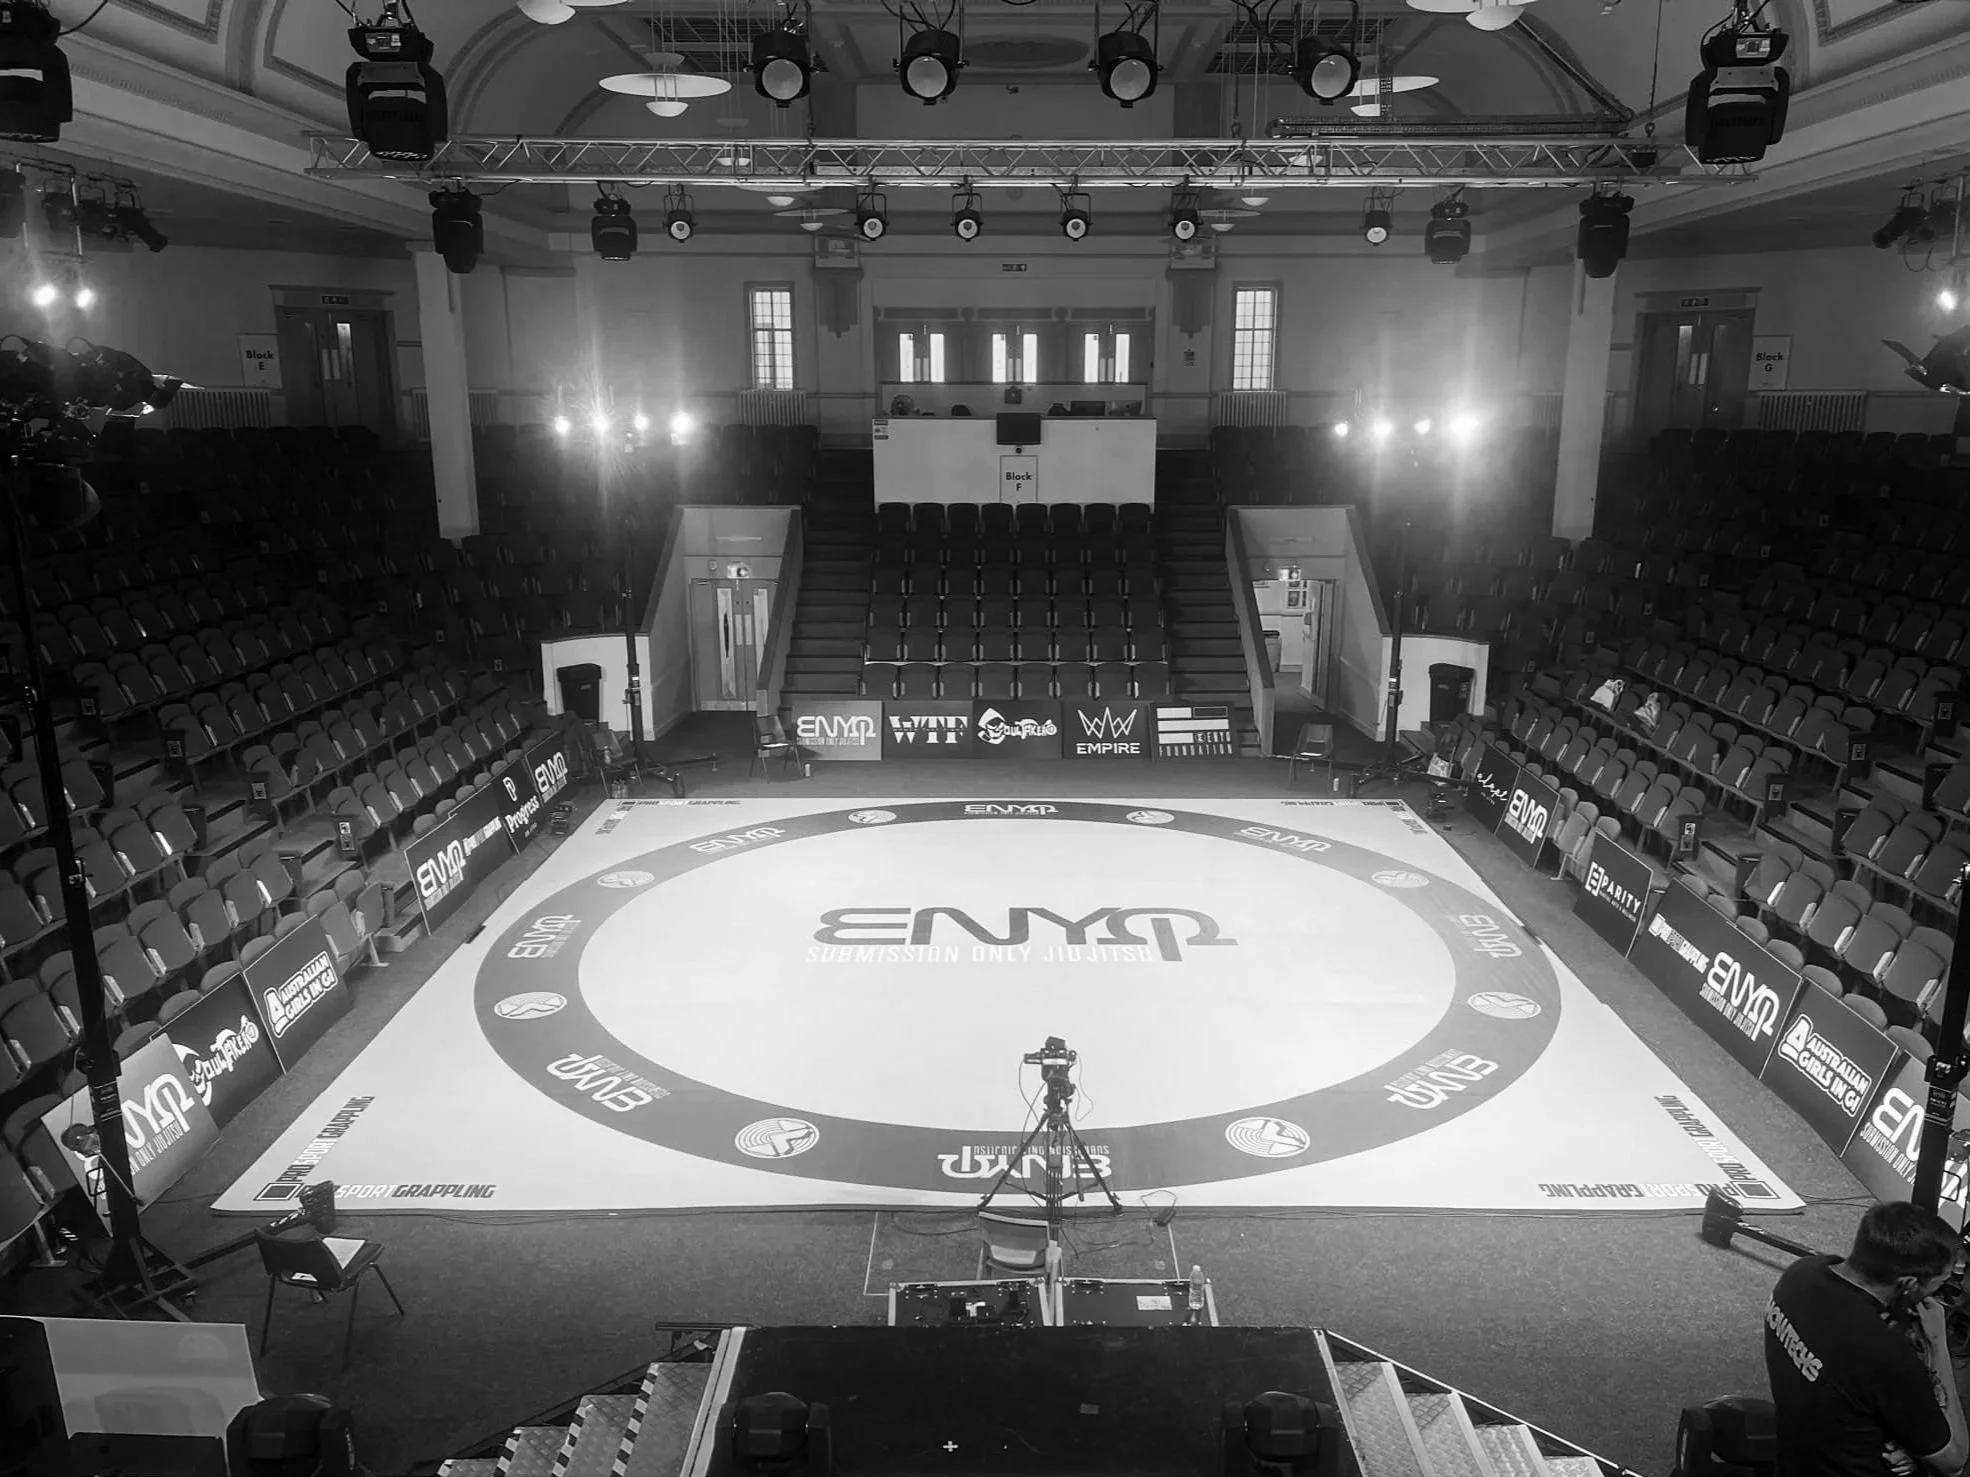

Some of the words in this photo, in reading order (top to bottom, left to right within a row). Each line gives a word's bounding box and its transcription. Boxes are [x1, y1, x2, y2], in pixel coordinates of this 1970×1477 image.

[246, 350, 274, 359] Block
[1756, 352, 1784, 361] Block
[258, 362, 265, 371] E
[1764, 363, 1773, 372] G
[1005, 471, 1032, 481] Block
[1016, 483, 1022, 492] F
[888, 715, 968, 744] WTF
[1076, 742, 1141, 755] EMPIRE
[1602, 875, 1642, 914] PARITY
[805, 945, 959, 963] SUBMISSION
[972, 945, 1031, 963] ONLY
[281, 955, 329, 1005] AUSTRALIAN
[285, 988, 312, 1019] GIRLS
[308, 978, 323, 998] IN
[321, 968, 334, 987] GI
[1806, 1036, 1869, 1095] AUSTRALIAN
[1799, 1051, 1834, 1087] GIRLS
[1829, 1076, 1848, 1100] IN
[1844, 1090, 1860, 1112] GI
